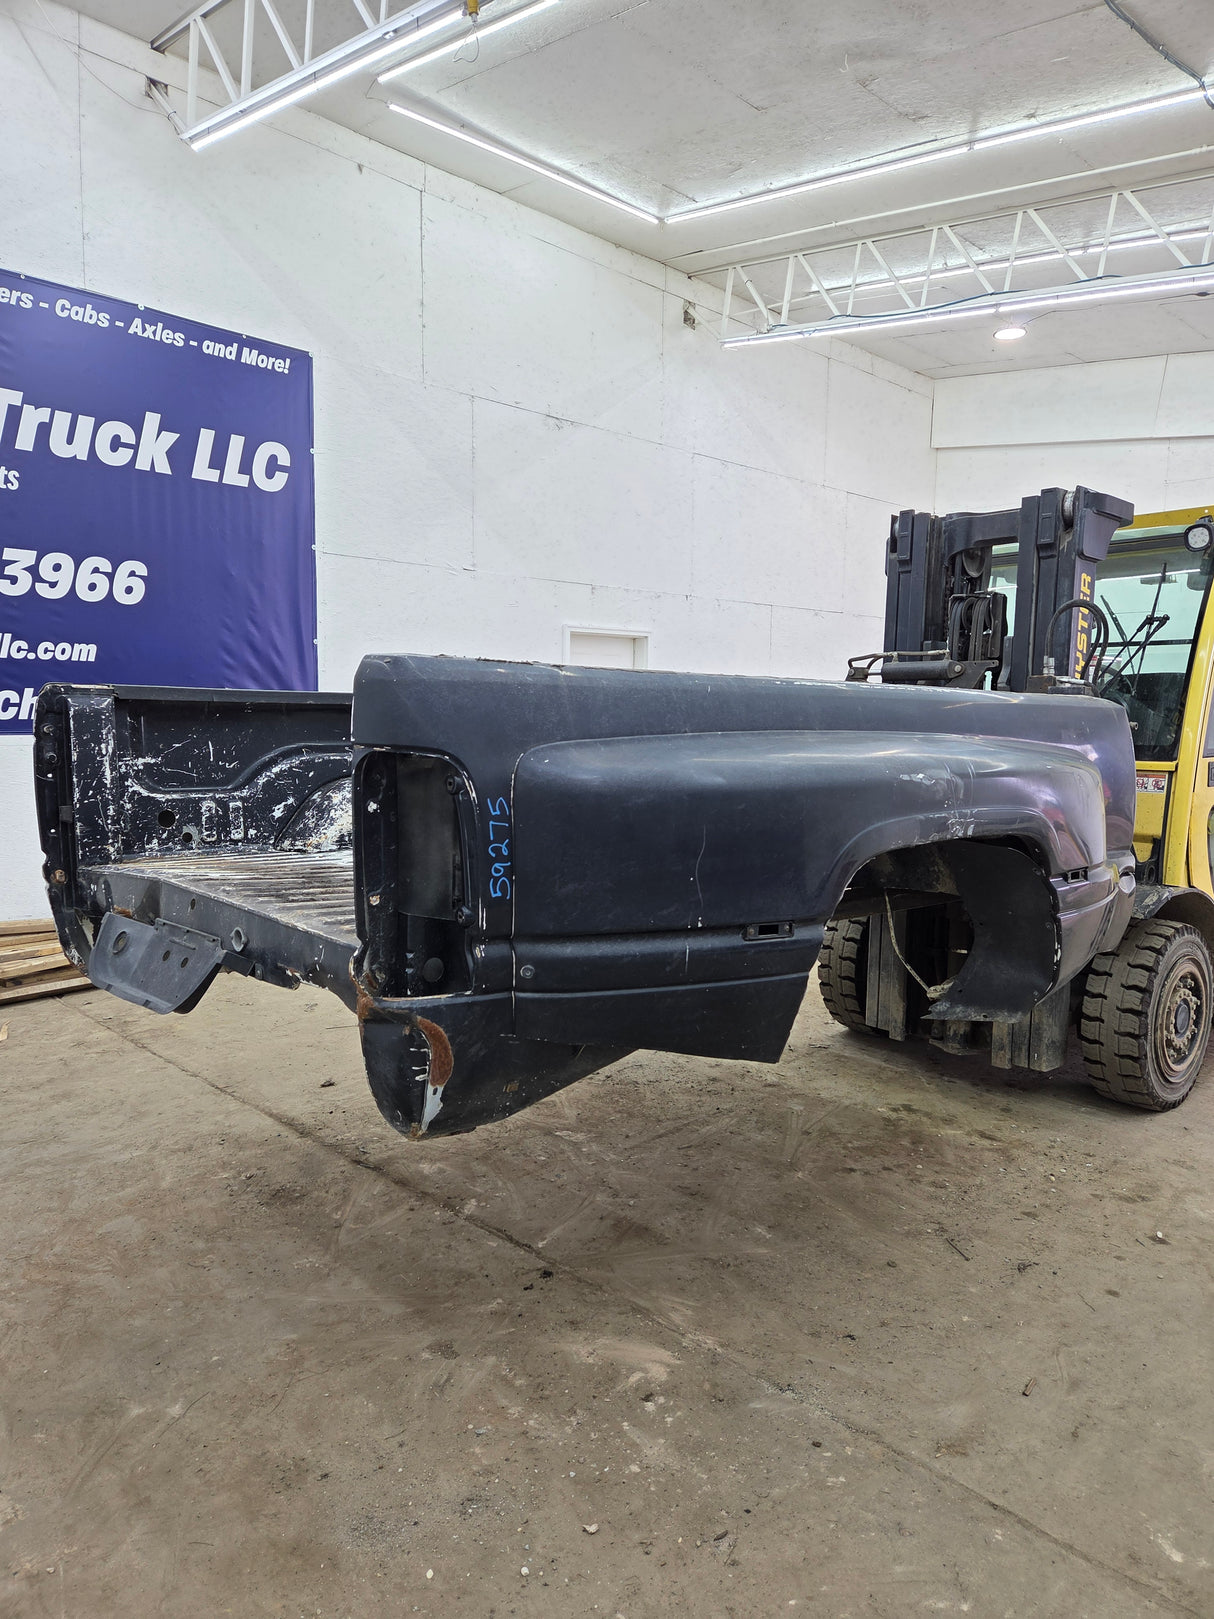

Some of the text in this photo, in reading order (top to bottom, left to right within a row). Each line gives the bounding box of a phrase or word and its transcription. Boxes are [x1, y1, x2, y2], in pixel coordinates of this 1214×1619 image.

[54, 298, 111, 328] Cabs
[127, 317, 186, 347] Axles
[202, 340, 239, 361] and
[240, 346, 291, 374] More!
[0, 387, 291, 493] Truck LLC
[0, 547, 148, 605] 3966
[0, 633, 97, 662] lc.com
[487, 796, 512, 900] 59275
